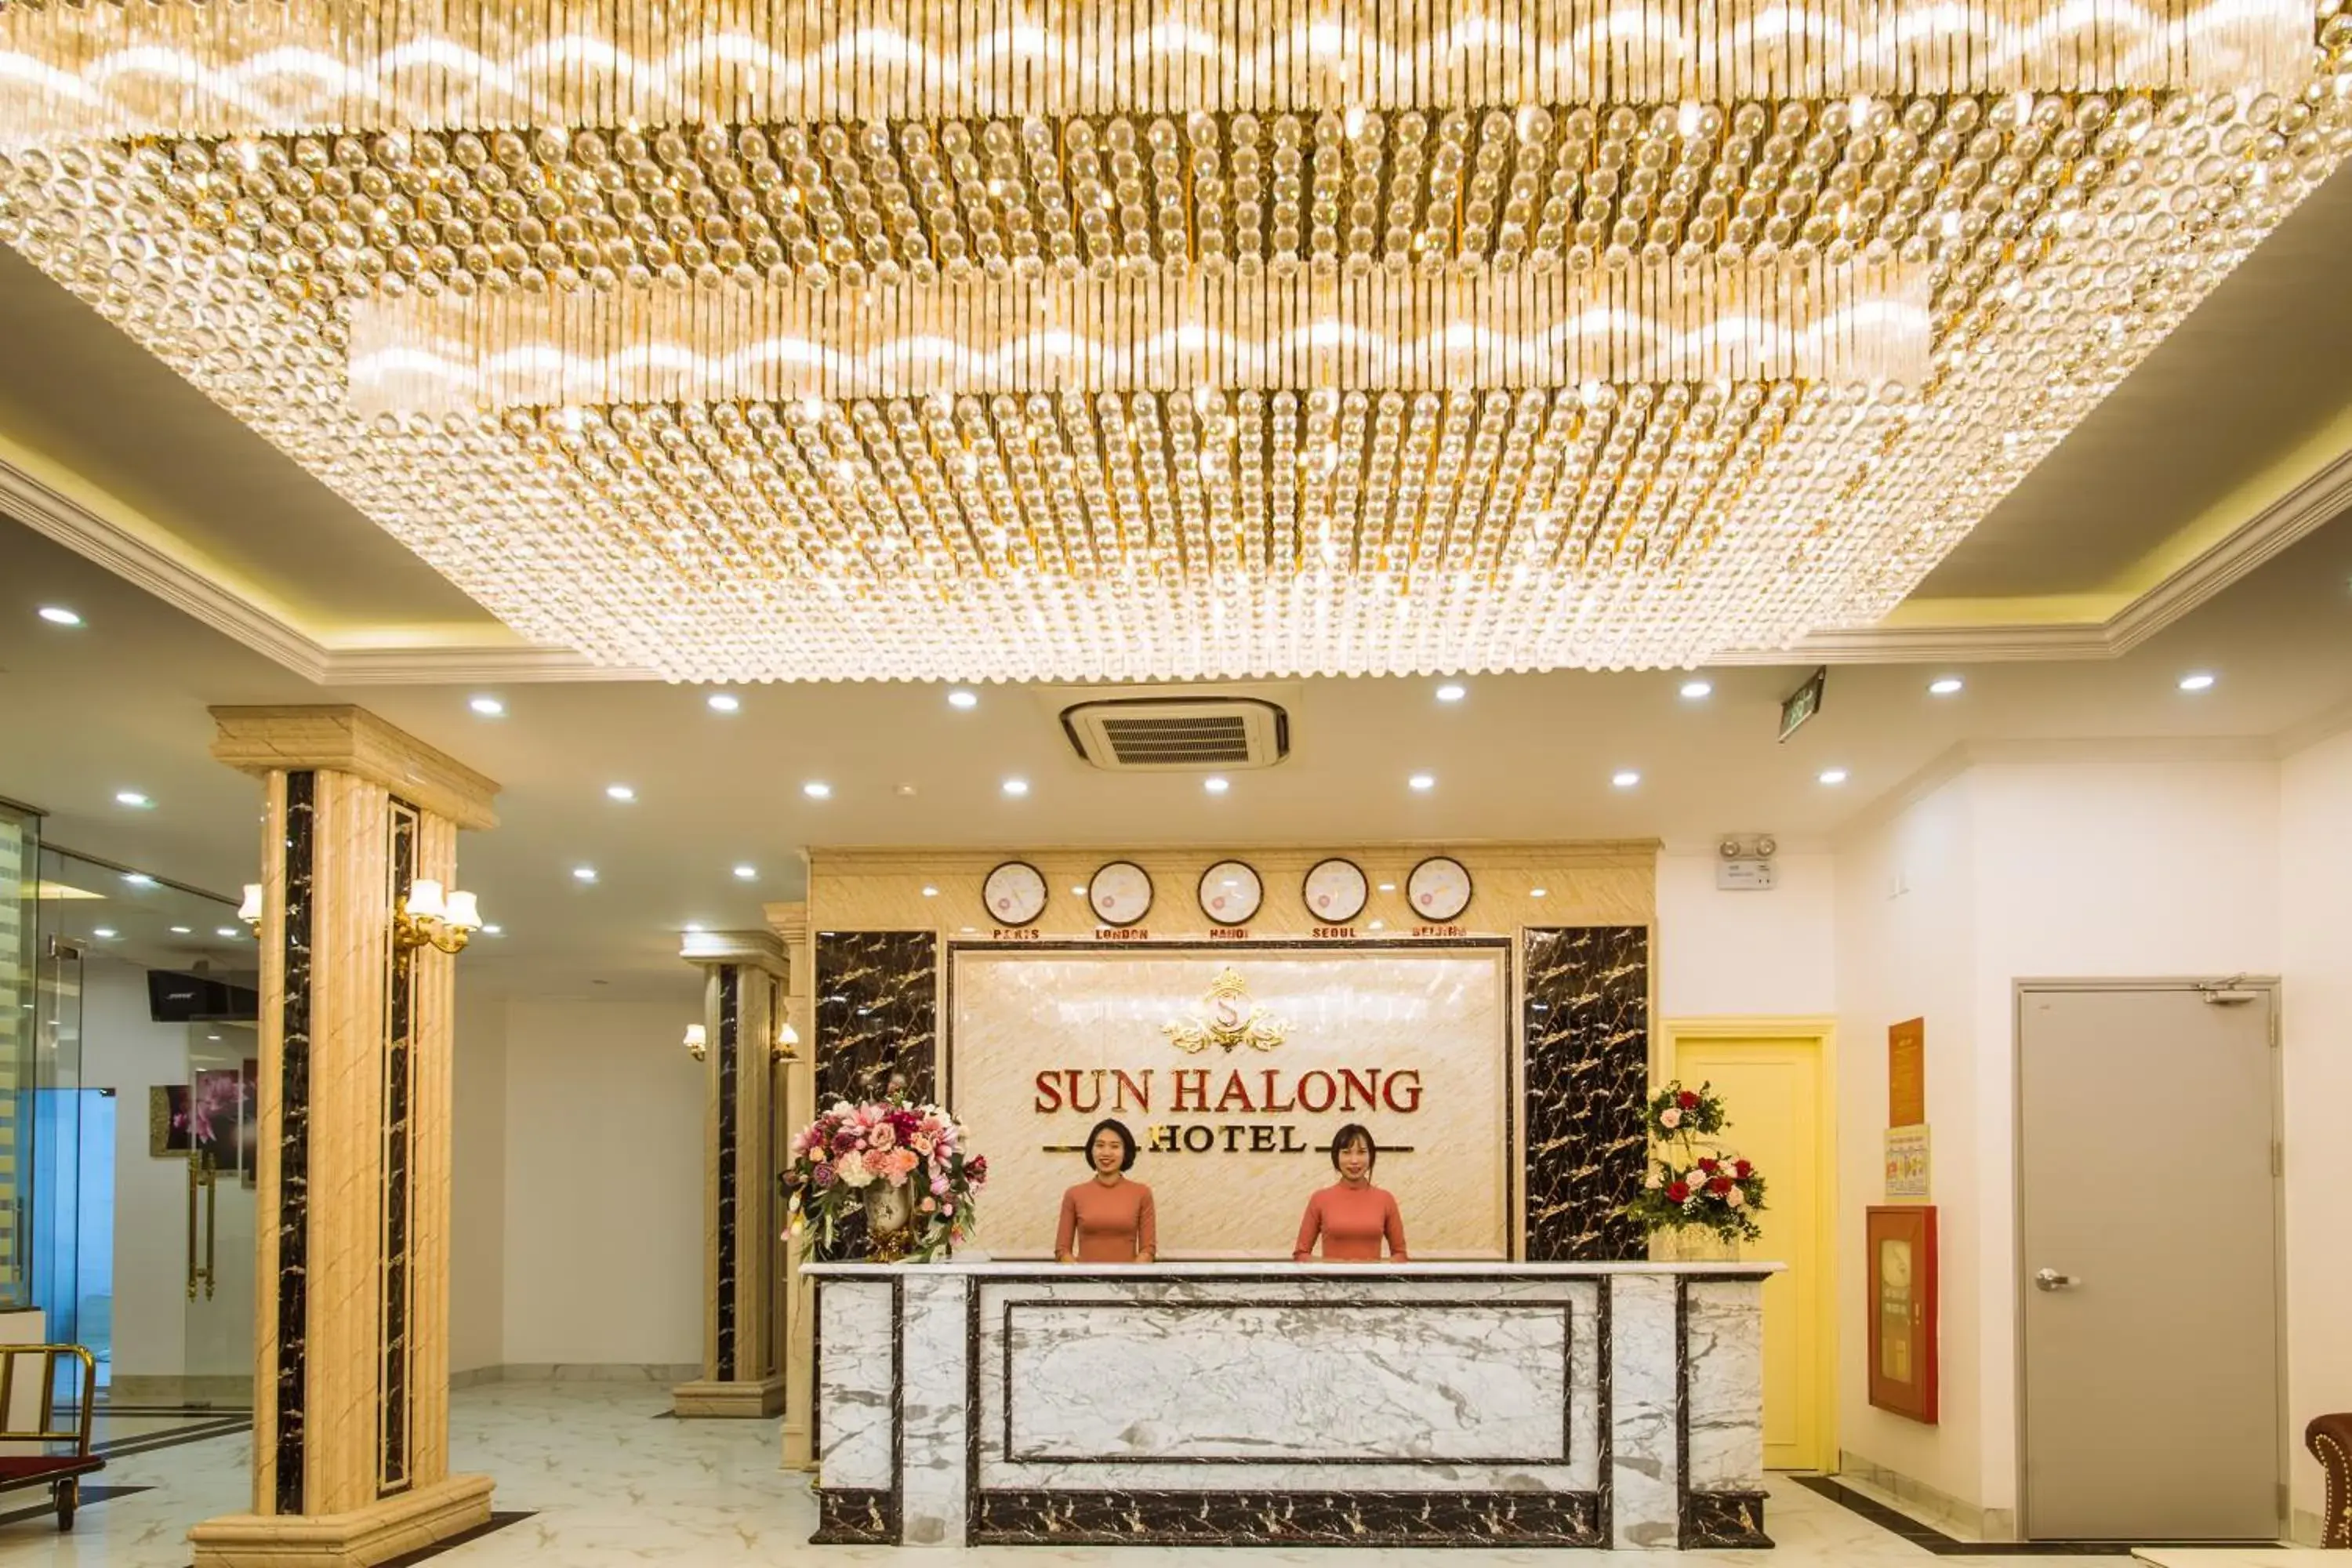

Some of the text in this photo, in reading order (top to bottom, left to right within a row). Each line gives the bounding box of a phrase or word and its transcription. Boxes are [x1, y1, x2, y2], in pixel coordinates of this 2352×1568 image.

[1095, 929, 1149, 939] LONDON
[1210, 929, 1249, 939] HANOI
[1312, 927, 1356, 938] SEOUL
[1035, 1069, 1424, 1114] SUN HALONG
[1148, 1124, 1308, 1152] HOTEL
